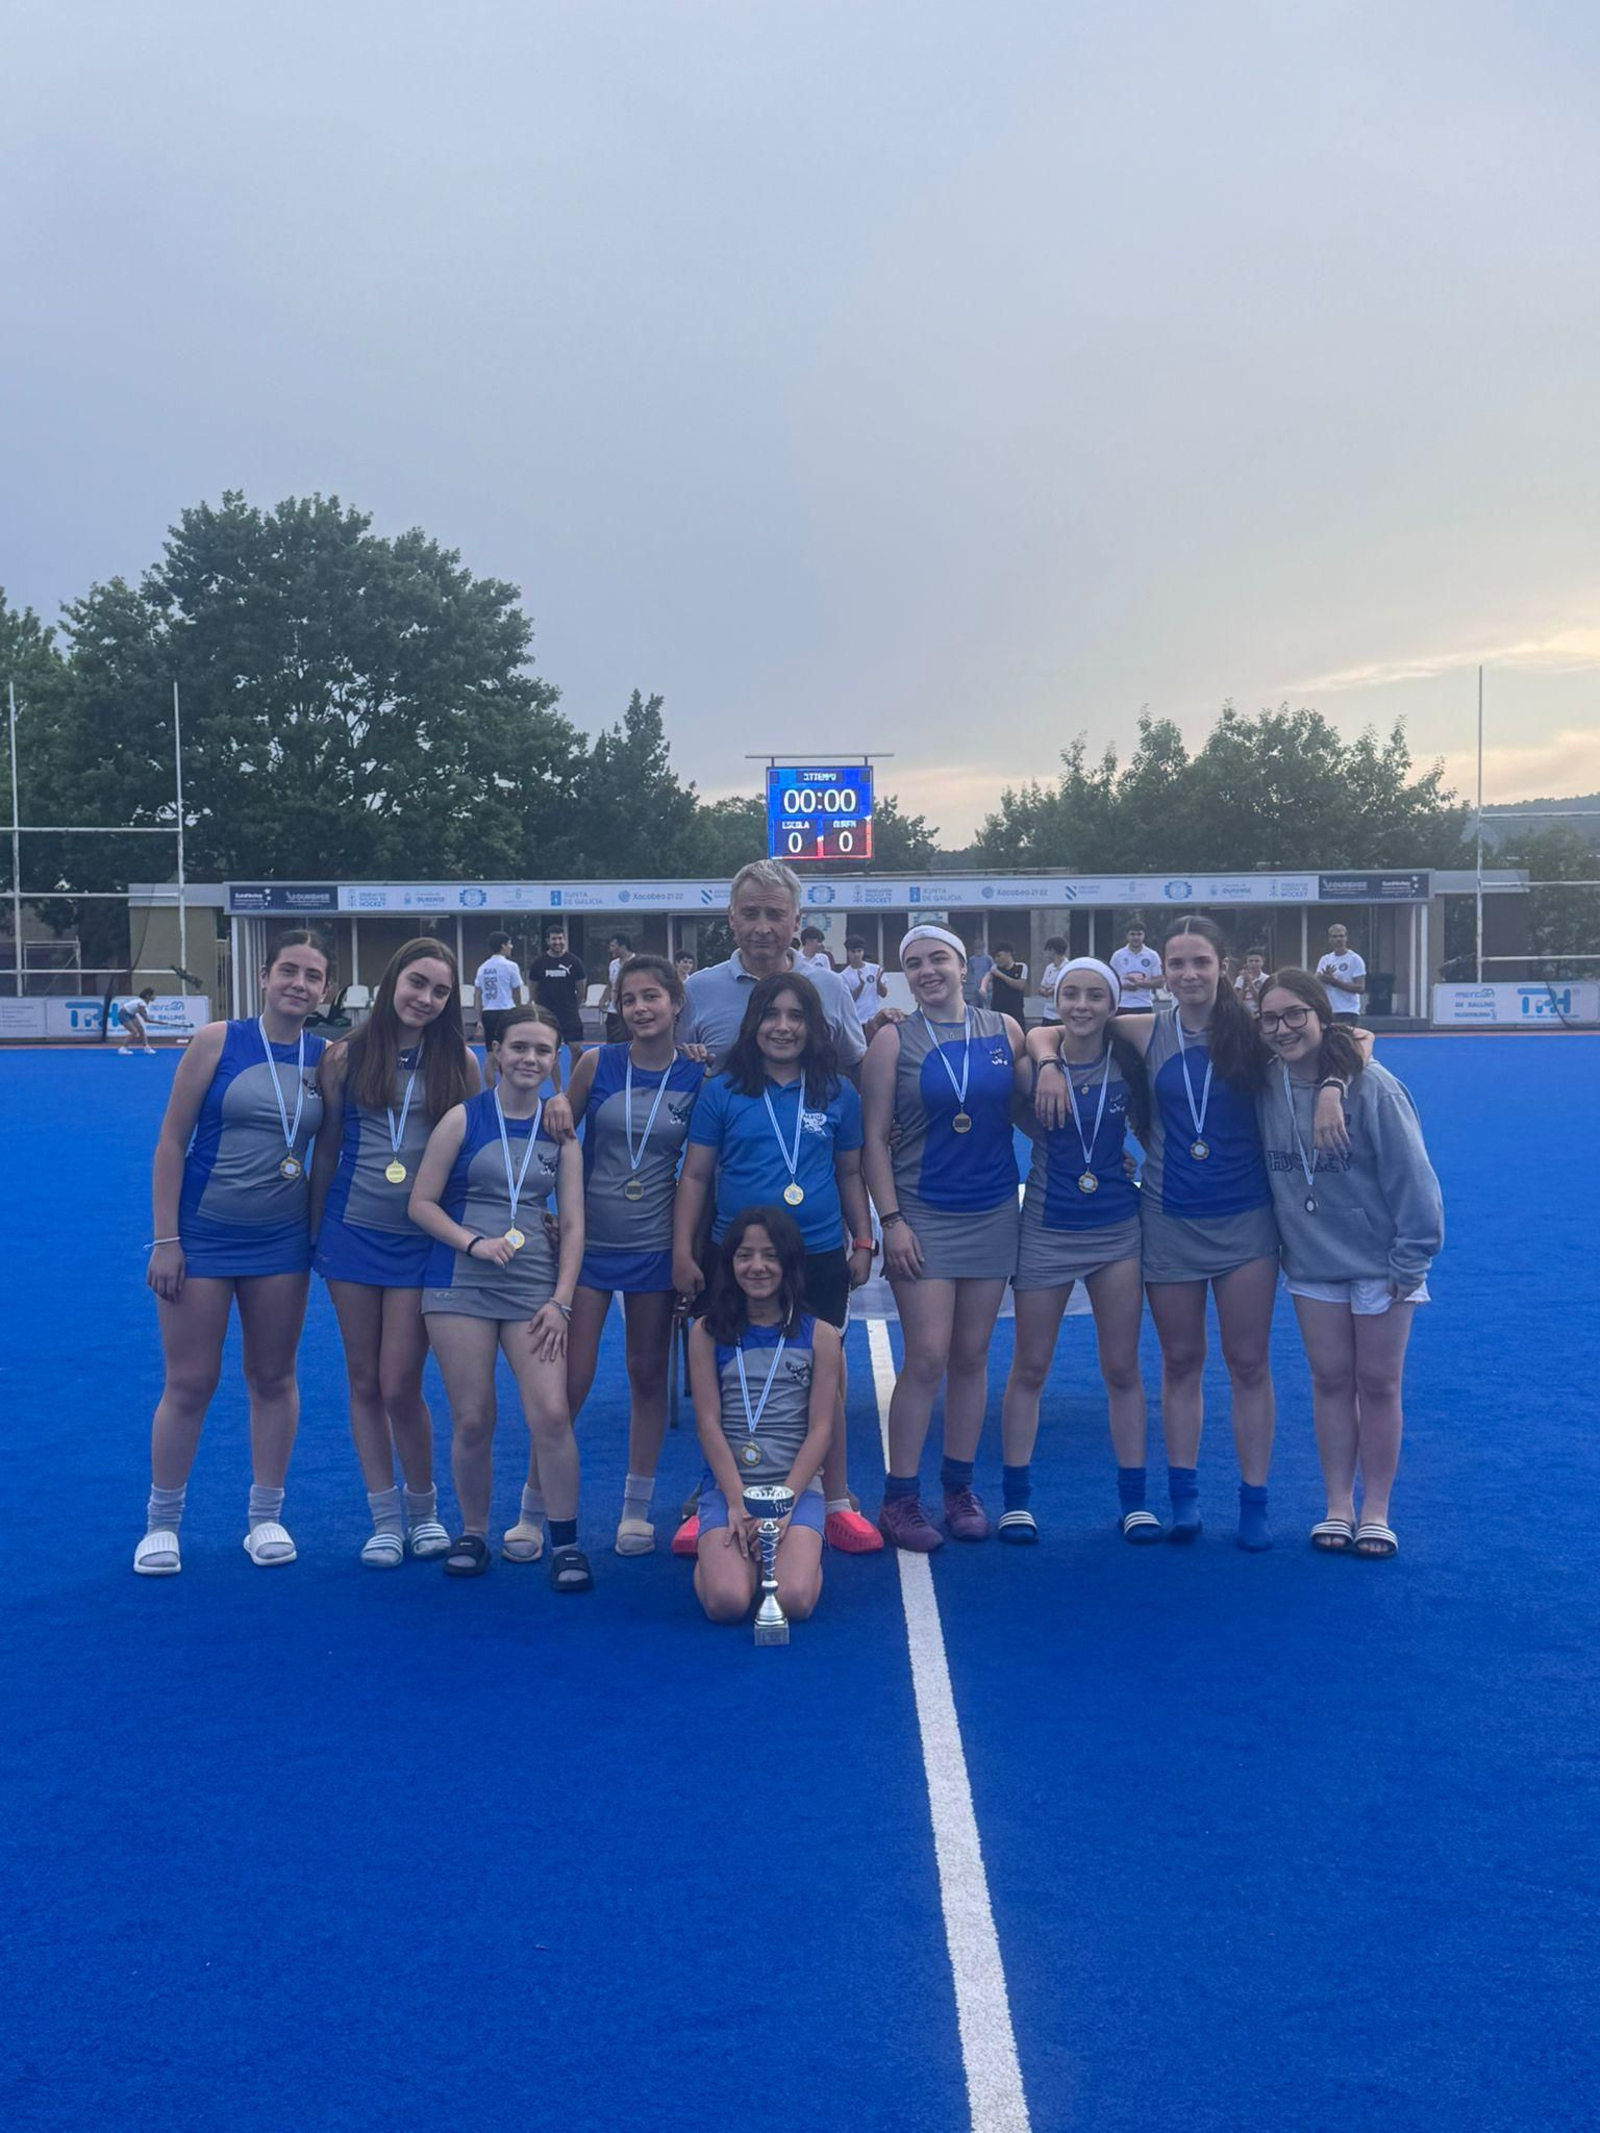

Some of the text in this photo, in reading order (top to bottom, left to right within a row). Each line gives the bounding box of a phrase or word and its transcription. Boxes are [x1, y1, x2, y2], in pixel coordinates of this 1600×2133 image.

[784, 789, 856, 813] 00:00
[788, 832, 802, 853] 0
[839, 831, 853, 852] 0
[545, 969, 567, 977] PUMA
